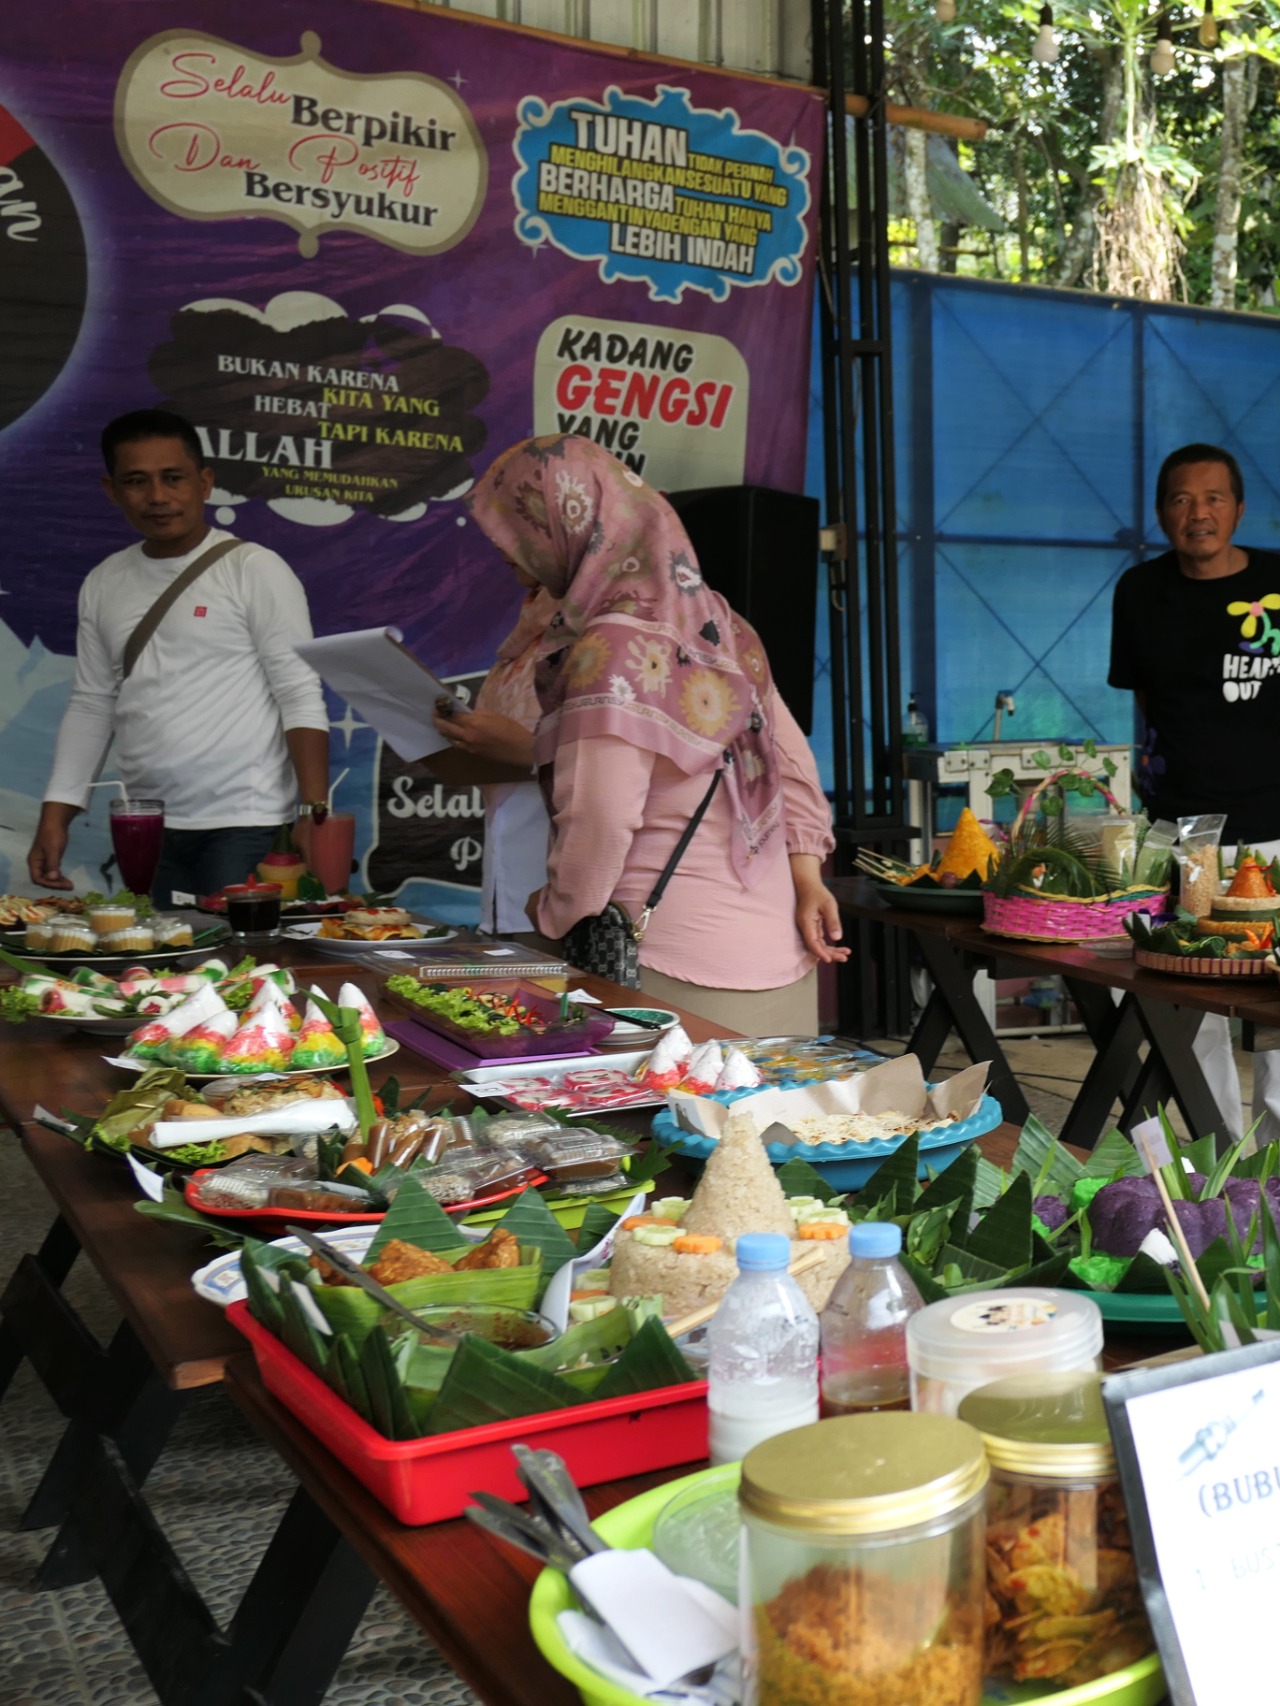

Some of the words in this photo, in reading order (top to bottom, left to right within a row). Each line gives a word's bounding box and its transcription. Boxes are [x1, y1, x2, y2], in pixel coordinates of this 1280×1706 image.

[160, 52, 292, 104] Selalu
[292, 94, 456, 151] Berpikir
[571, 111, 688, 168] TUHAN
[149, 122, 260, 172] Dan
[289, 134, 420, 197] Positif
[688, 153, 724, 173] TIDAK
[725, 161, 774, 184] PERNAH
[244, 171, 438, 227] Bersyukur
[540, 162, 675, 213] BERHARGA
[754, 182, 788, 207] YANG
[675, 196, 726, 221] TUHAN
[728, 205, 773, 232] HANYA
[611, 222, 680, 261] LEBIH
[687, 236, 754, 274] INDAH
[724, 222, 758, 247] YANG
[556, 326, 694, 373] KADANG
[218, 355, 300, 381] BUKAN
[307, 365, 400, 392] KARENA
[254, 395, 332, 419] HEBAT
[323, 387, 374, 409] KITA
[382, 394, 441, 417] YANG
[556, 363, 734, 429] GENGSI
[317, 421, 369, 442] TAPI
[375, 427, 464, 453] KARENA
[557, 413, 640, 450] YANG
[262, 466, 299, 480] YANG
[303, 470, 399, 489] MEMUDAHKAN
[285, 484, 340, 499] URUSAN
[343, 489, 375, 502] KITA
[1223, 681, 1263, 703] OUT
